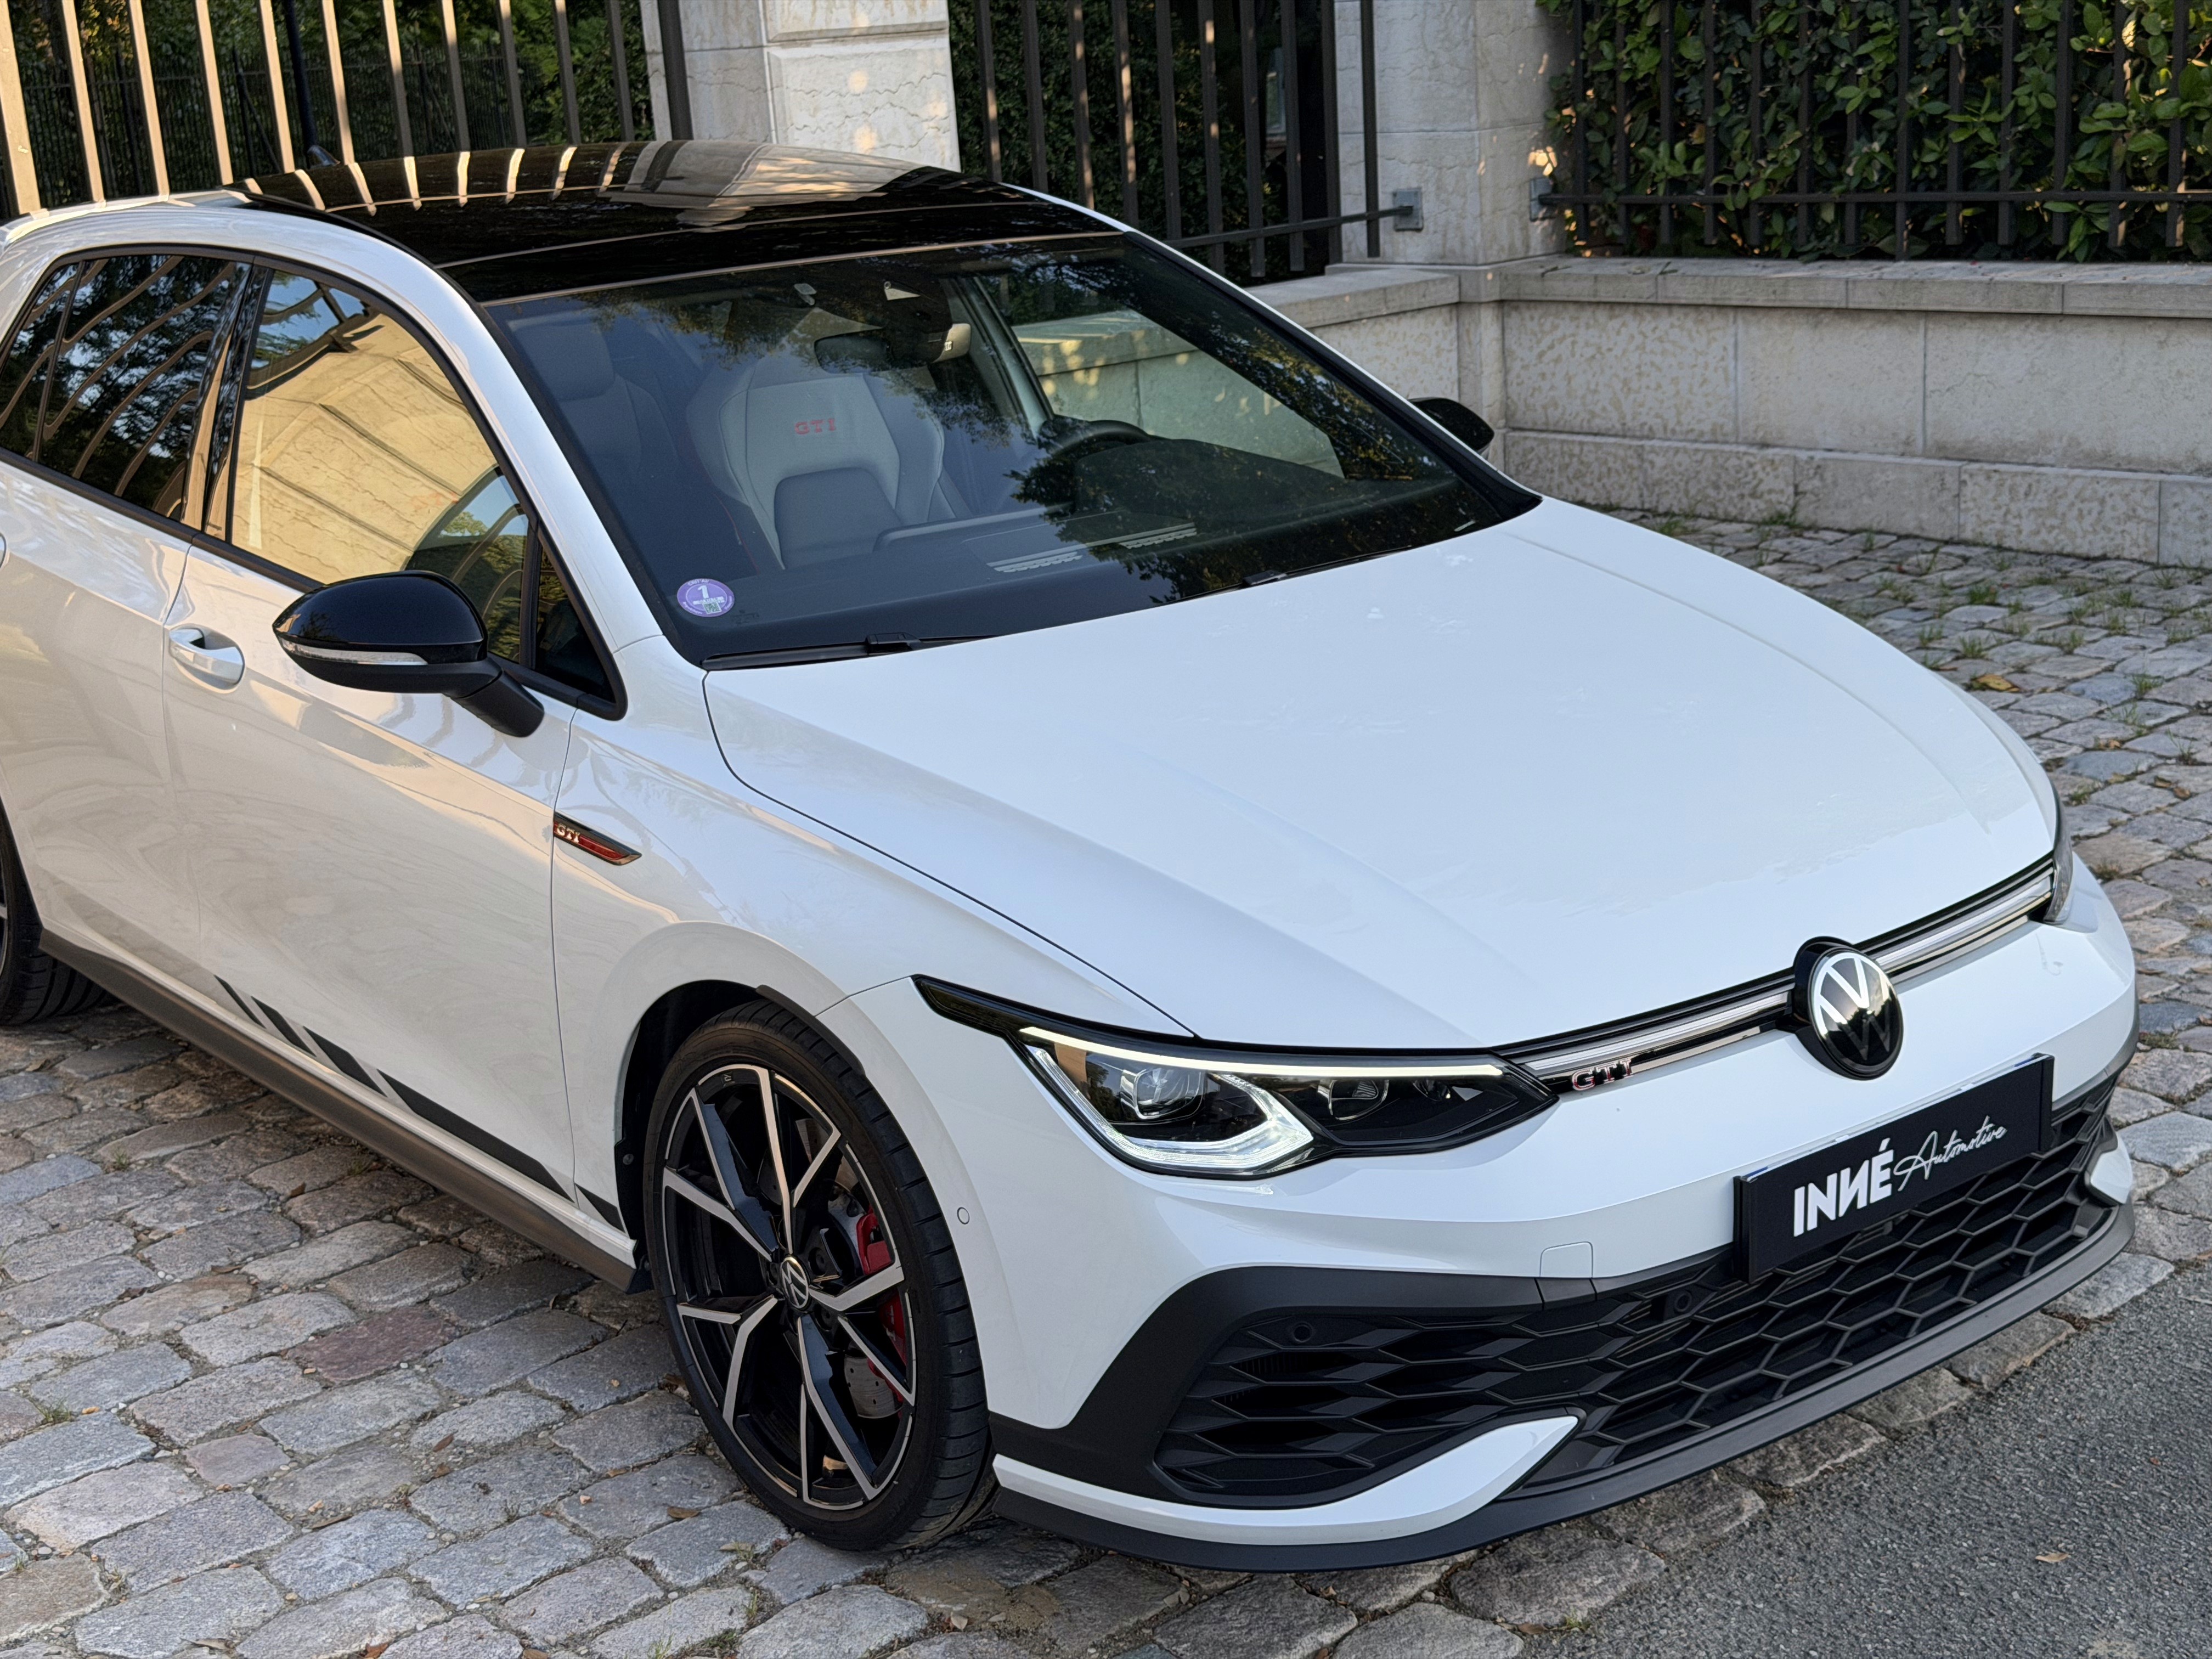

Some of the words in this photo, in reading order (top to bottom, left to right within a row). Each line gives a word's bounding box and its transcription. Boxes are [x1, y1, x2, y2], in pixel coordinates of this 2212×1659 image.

[795, 417, 836, 435] GTI
[697, 585, 709, 599] 1
[557, 824, 580, 843] GTI
[1572, 1058, 1634, 1091] GTI
[1893, 1115, 2008, 1192] Automotive
